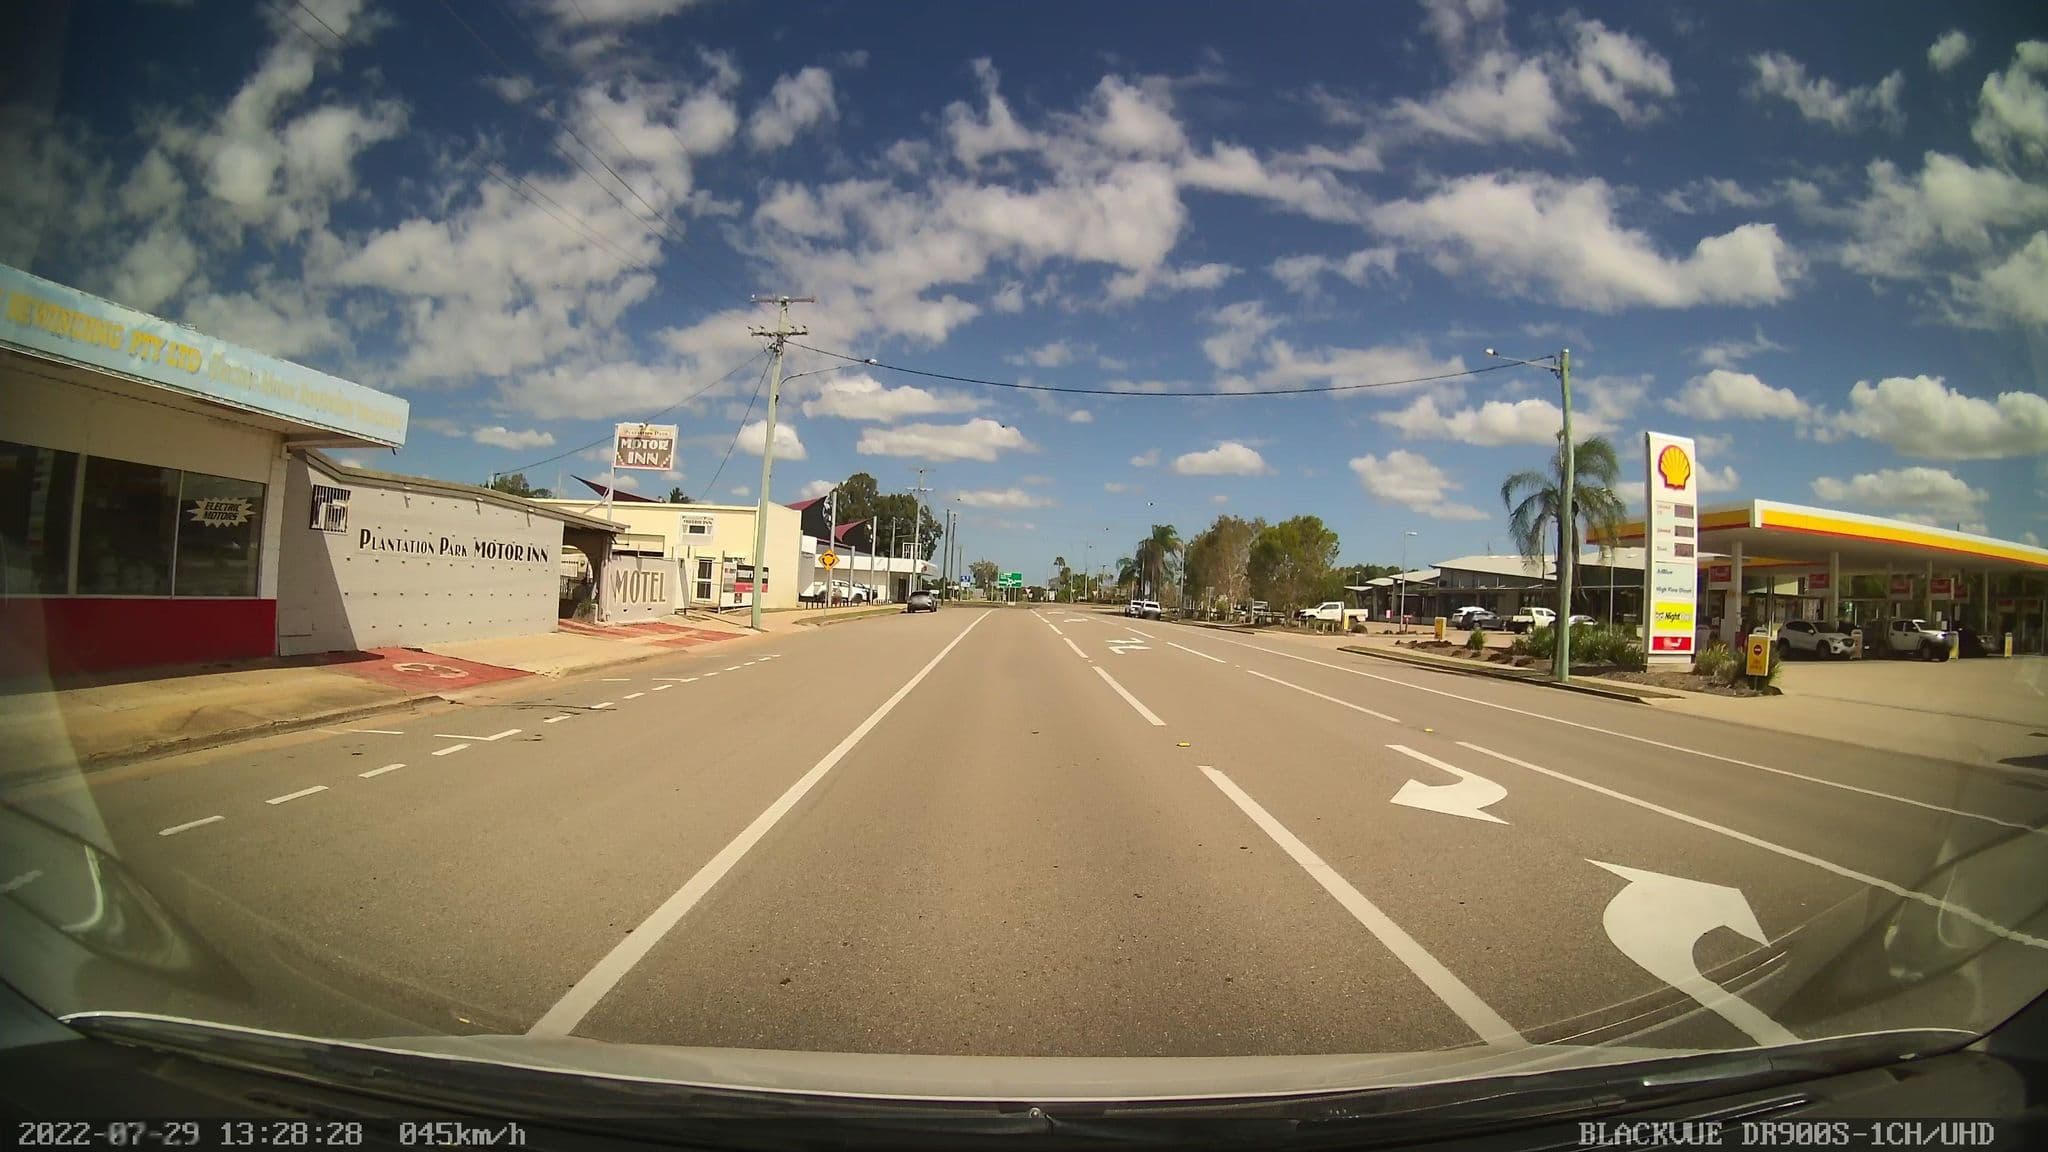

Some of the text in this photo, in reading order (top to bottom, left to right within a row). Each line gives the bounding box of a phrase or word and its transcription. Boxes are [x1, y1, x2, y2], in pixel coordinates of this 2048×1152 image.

[129, 329, 167, 362] PTY
[167, 341, 201, 374] LTD
[621, 438, 669, 451] MOTOR
[627, 451, 659, 466] INN
[205, 501, 241, 512] ELECTRIC
[203, 511, 239, 521] MOTORS
[473, 540, 524, 562] MOTOR
[527, 544, 549, 564] INN
[610, 569, 666, 604] MOTEL
[1665, 611, 1681, 623] Night
